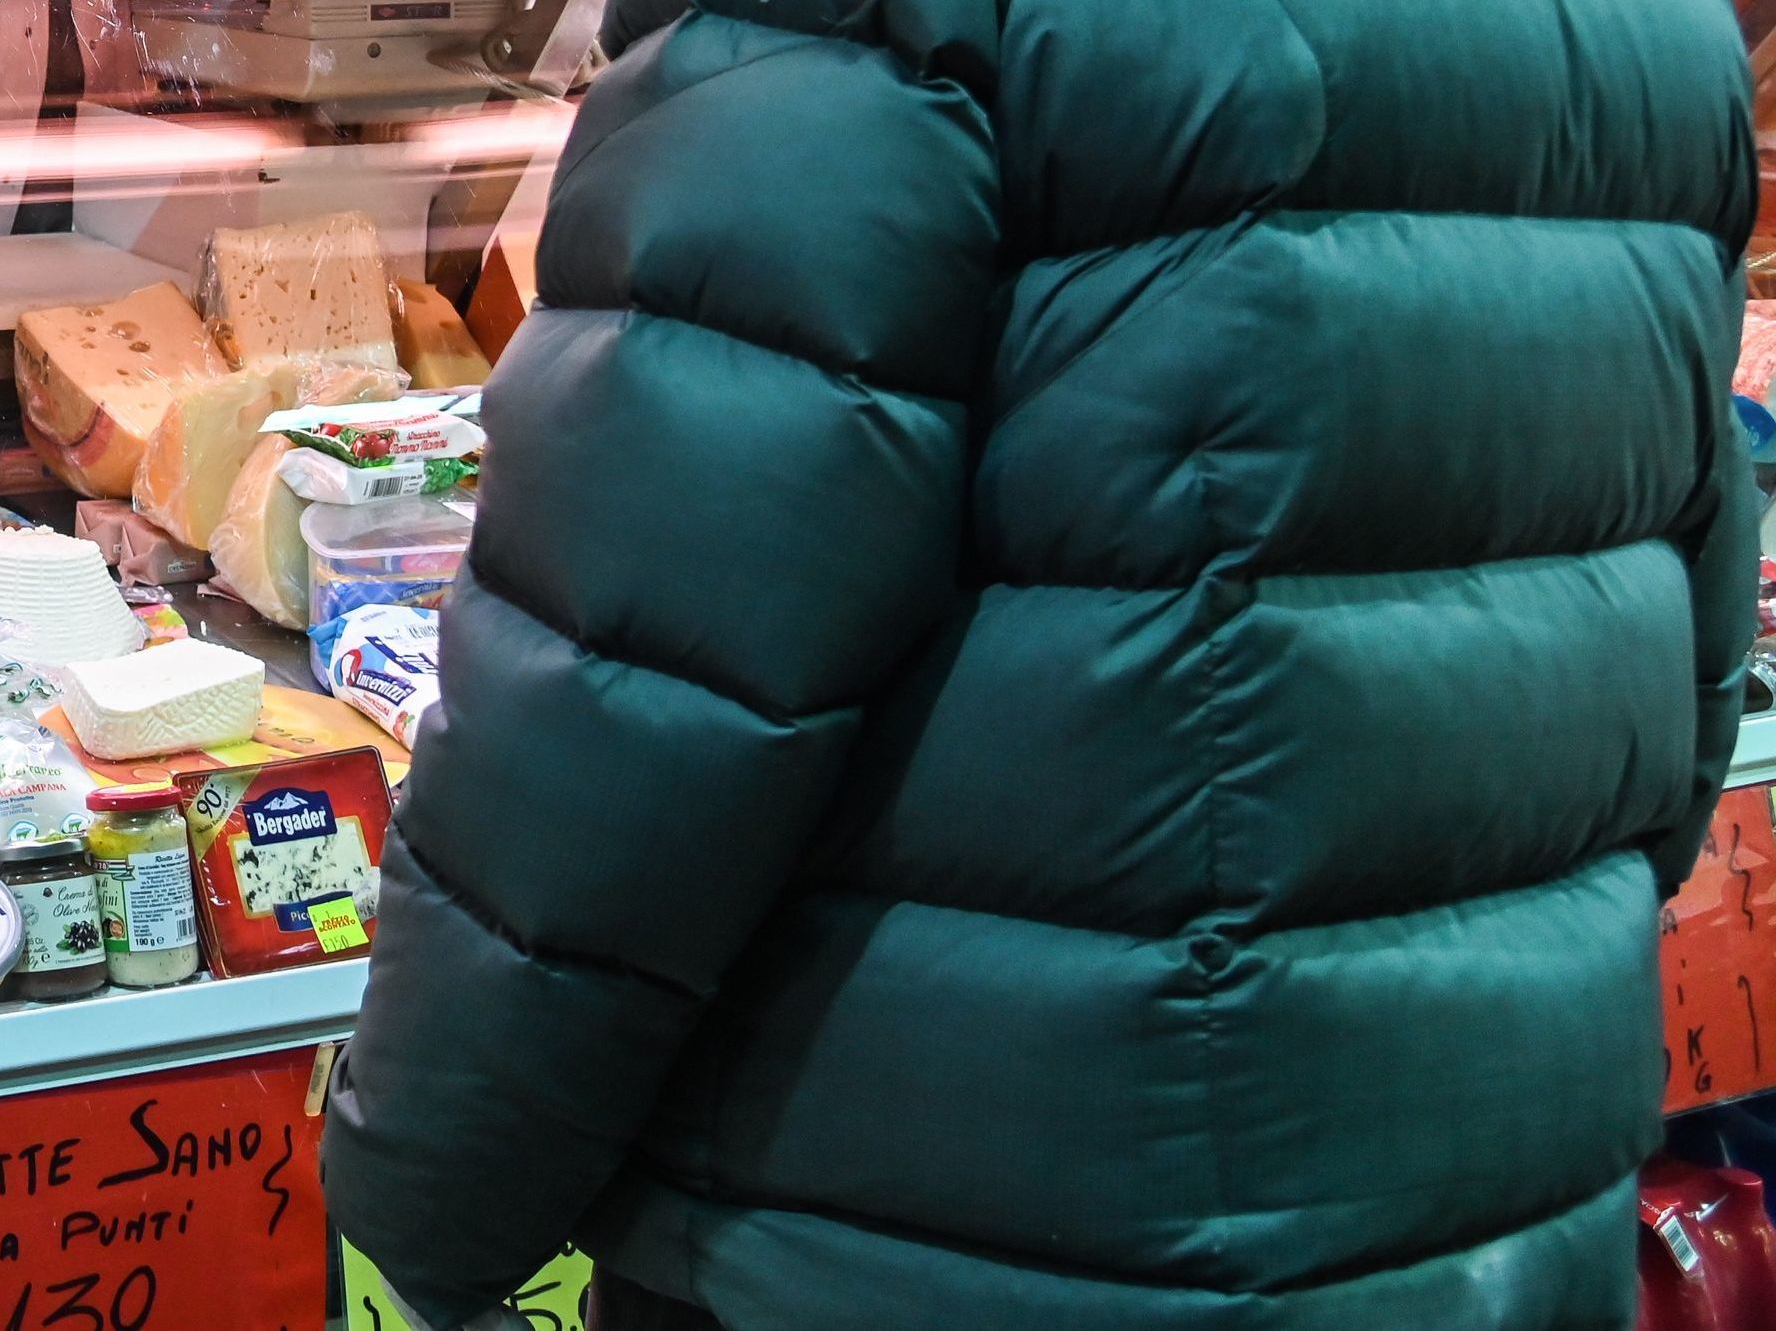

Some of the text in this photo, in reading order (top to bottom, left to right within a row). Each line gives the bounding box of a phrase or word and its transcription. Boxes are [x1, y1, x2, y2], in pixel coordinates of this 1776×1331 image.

[355, 670, 409, 703] Invernizzi
[17, 783, 67, 797] CAMPANA
[253, 808, 328, 837] Bergader
[58, 886, 86, 901] Crema
[52, 903, 81, 918] Olive
[99, 1100, 262, 1187] SANO
